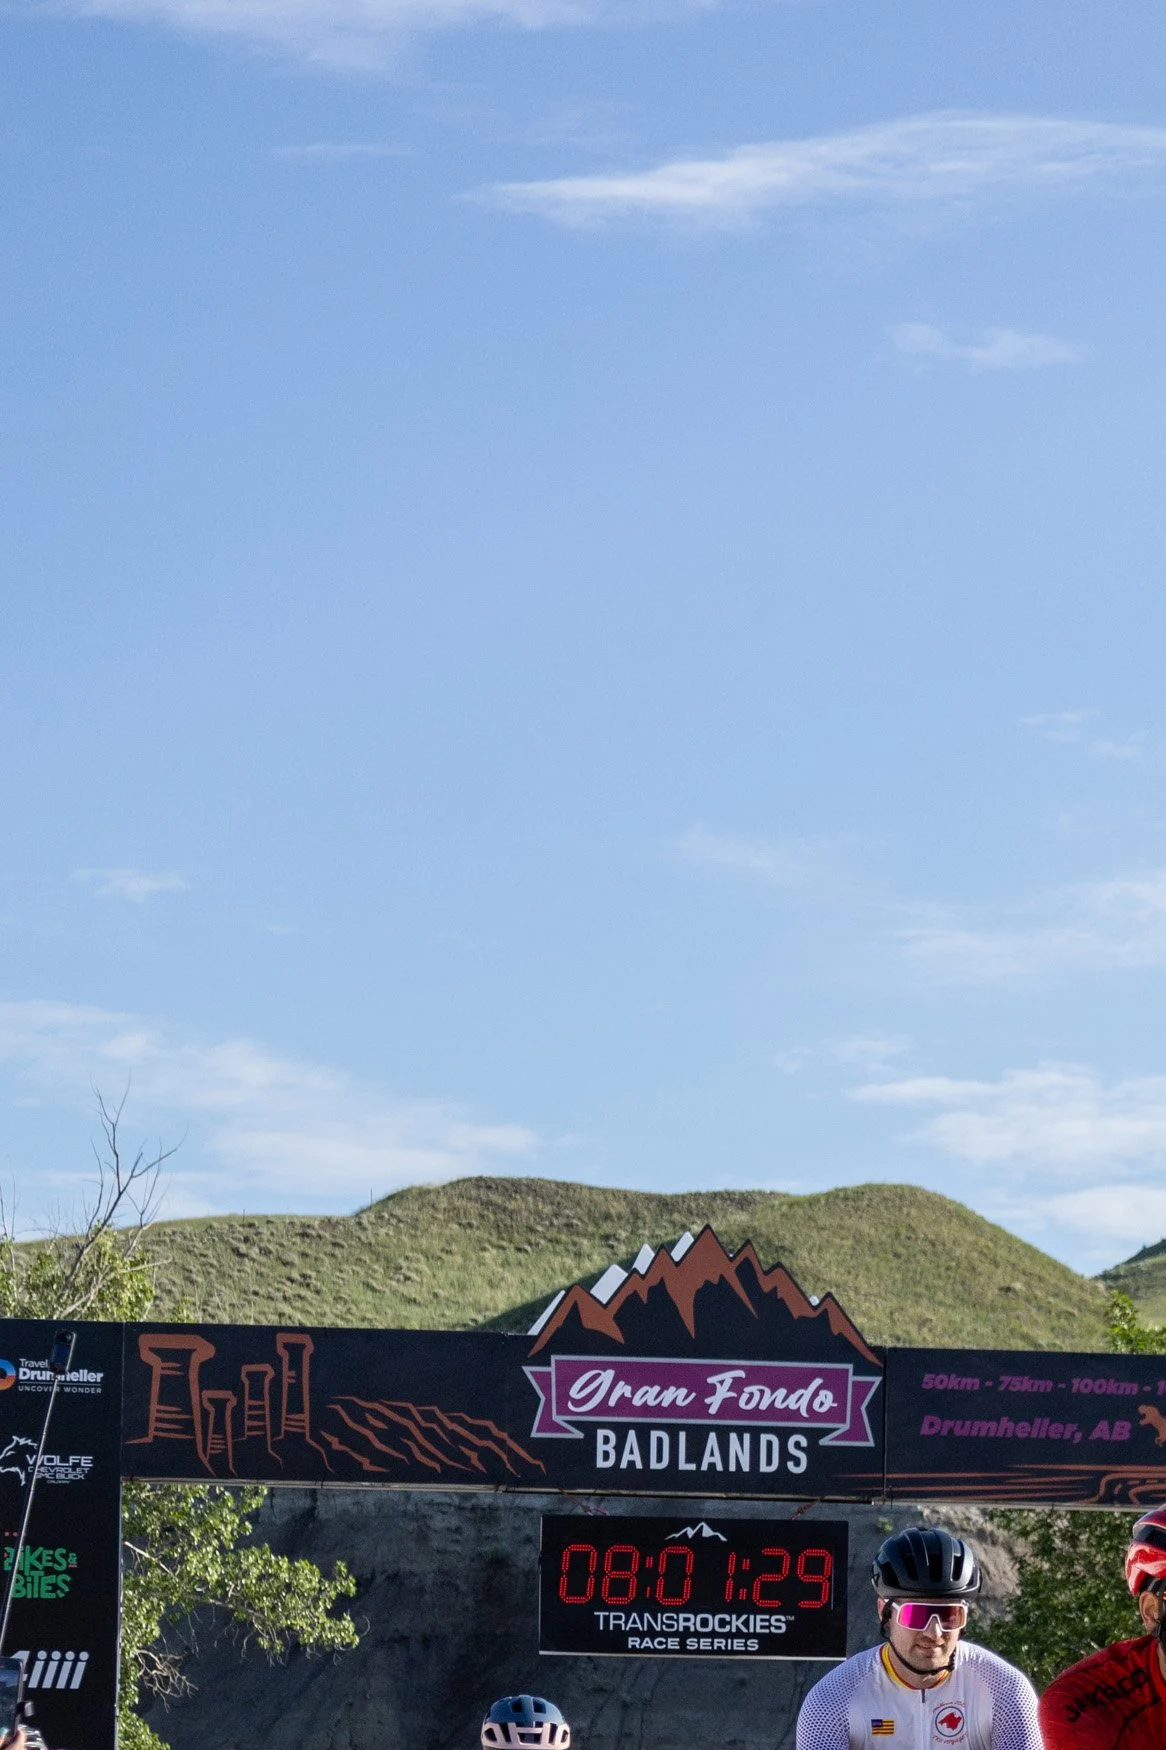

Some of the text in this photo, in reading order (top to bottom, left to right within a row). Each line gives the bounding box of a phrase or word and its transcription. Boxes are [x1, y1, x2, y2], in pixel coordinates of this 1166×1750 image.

[19, 1359, 48, 1368] Travel
[64, 1386, 102, 1394] WONDER
[568, 1369, 838, 1417] Gran Fondo
[922, 1374, 980, 1391] 50km
[998, 1376, 1053, 1392] 75km
[1071, 1378, 1138, 1395] 100km
[920, 1415, 1132, 1443] Drumheller, AB
[26, 1454, 93, 1467] WOLFE
[596, 1428, 808, 1474] BADLANDS
[559, 1544, 832, 1608] 08:01:29
[628, 1636, 759, 1651] RACE SERIES
